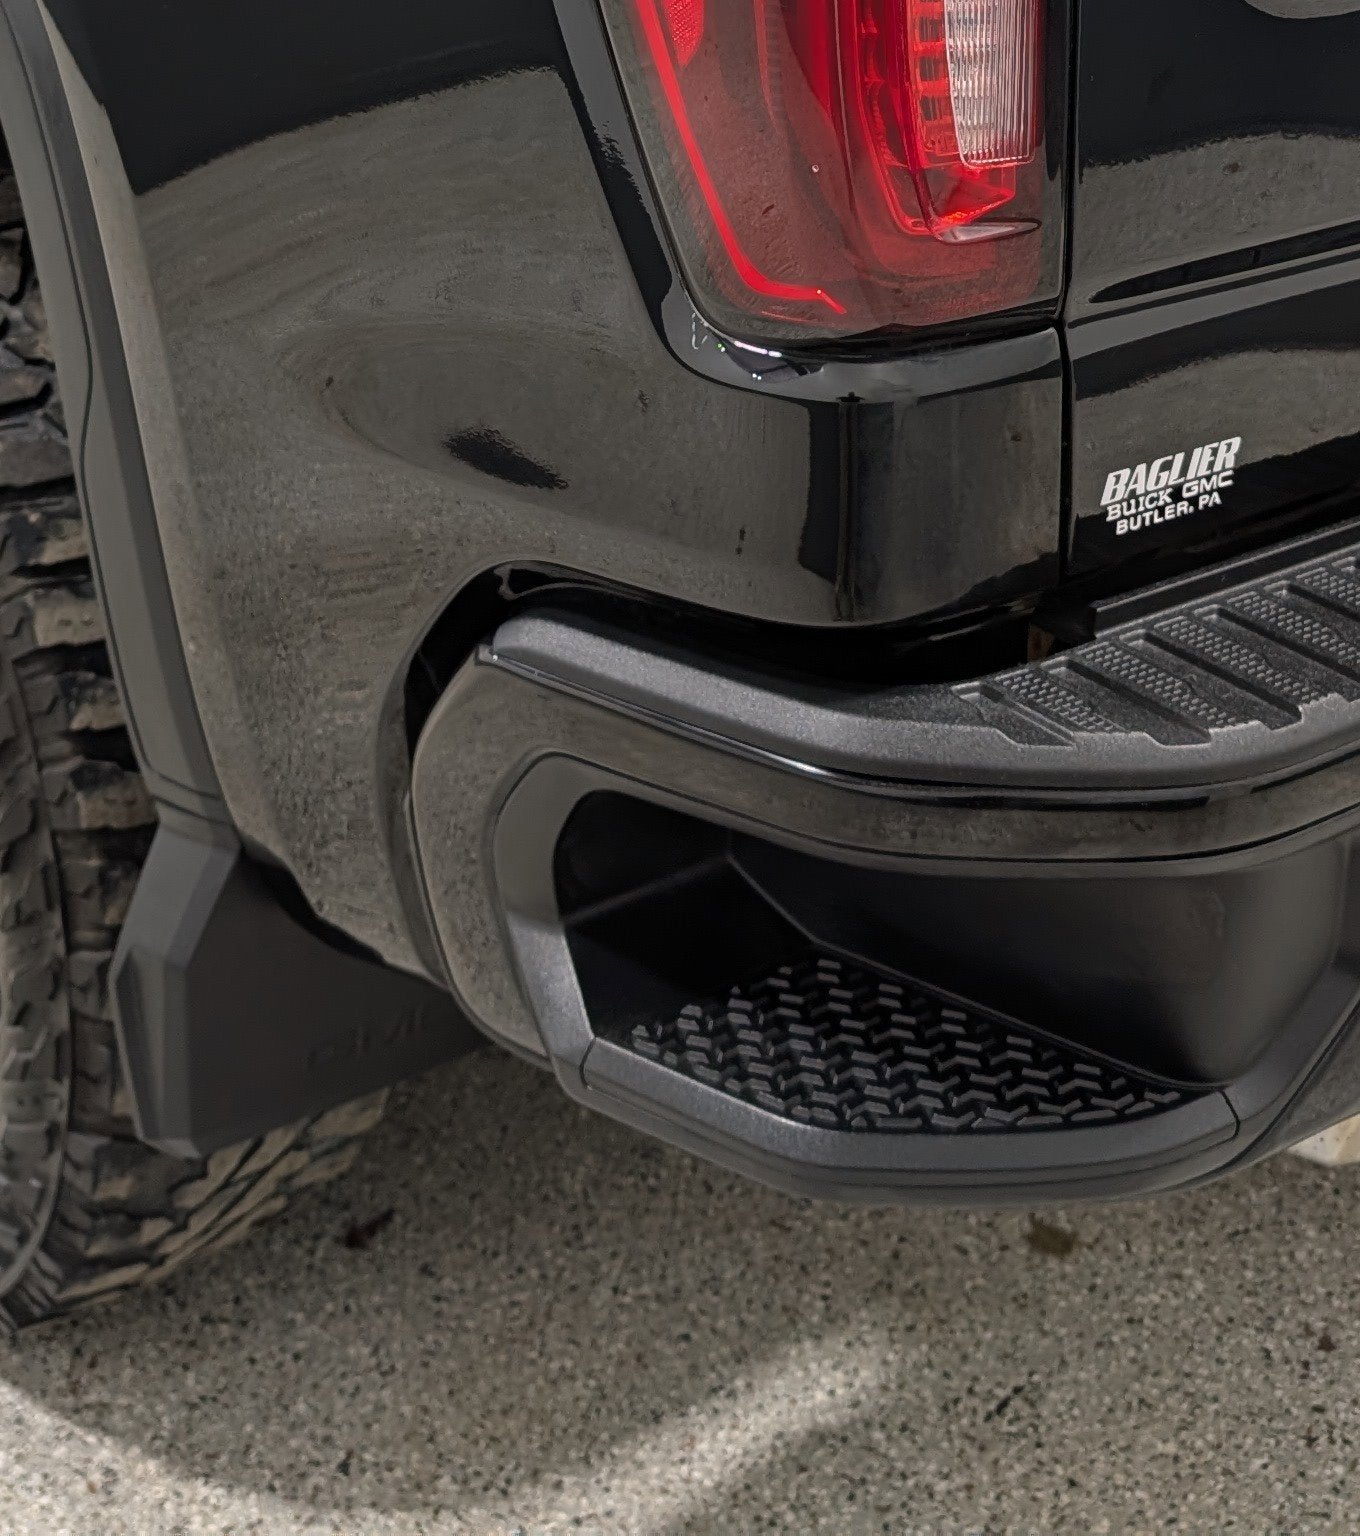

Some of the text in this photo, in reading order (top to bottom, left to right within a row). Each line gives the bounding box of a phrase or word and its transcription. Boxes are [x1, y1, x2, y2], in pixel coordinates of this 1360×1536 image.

[1100, 436, 1242, 506] BAGLIER
[1106, 469, 1234, 522] BUICK GMC
[1198, 491, 1222, 510] PA
